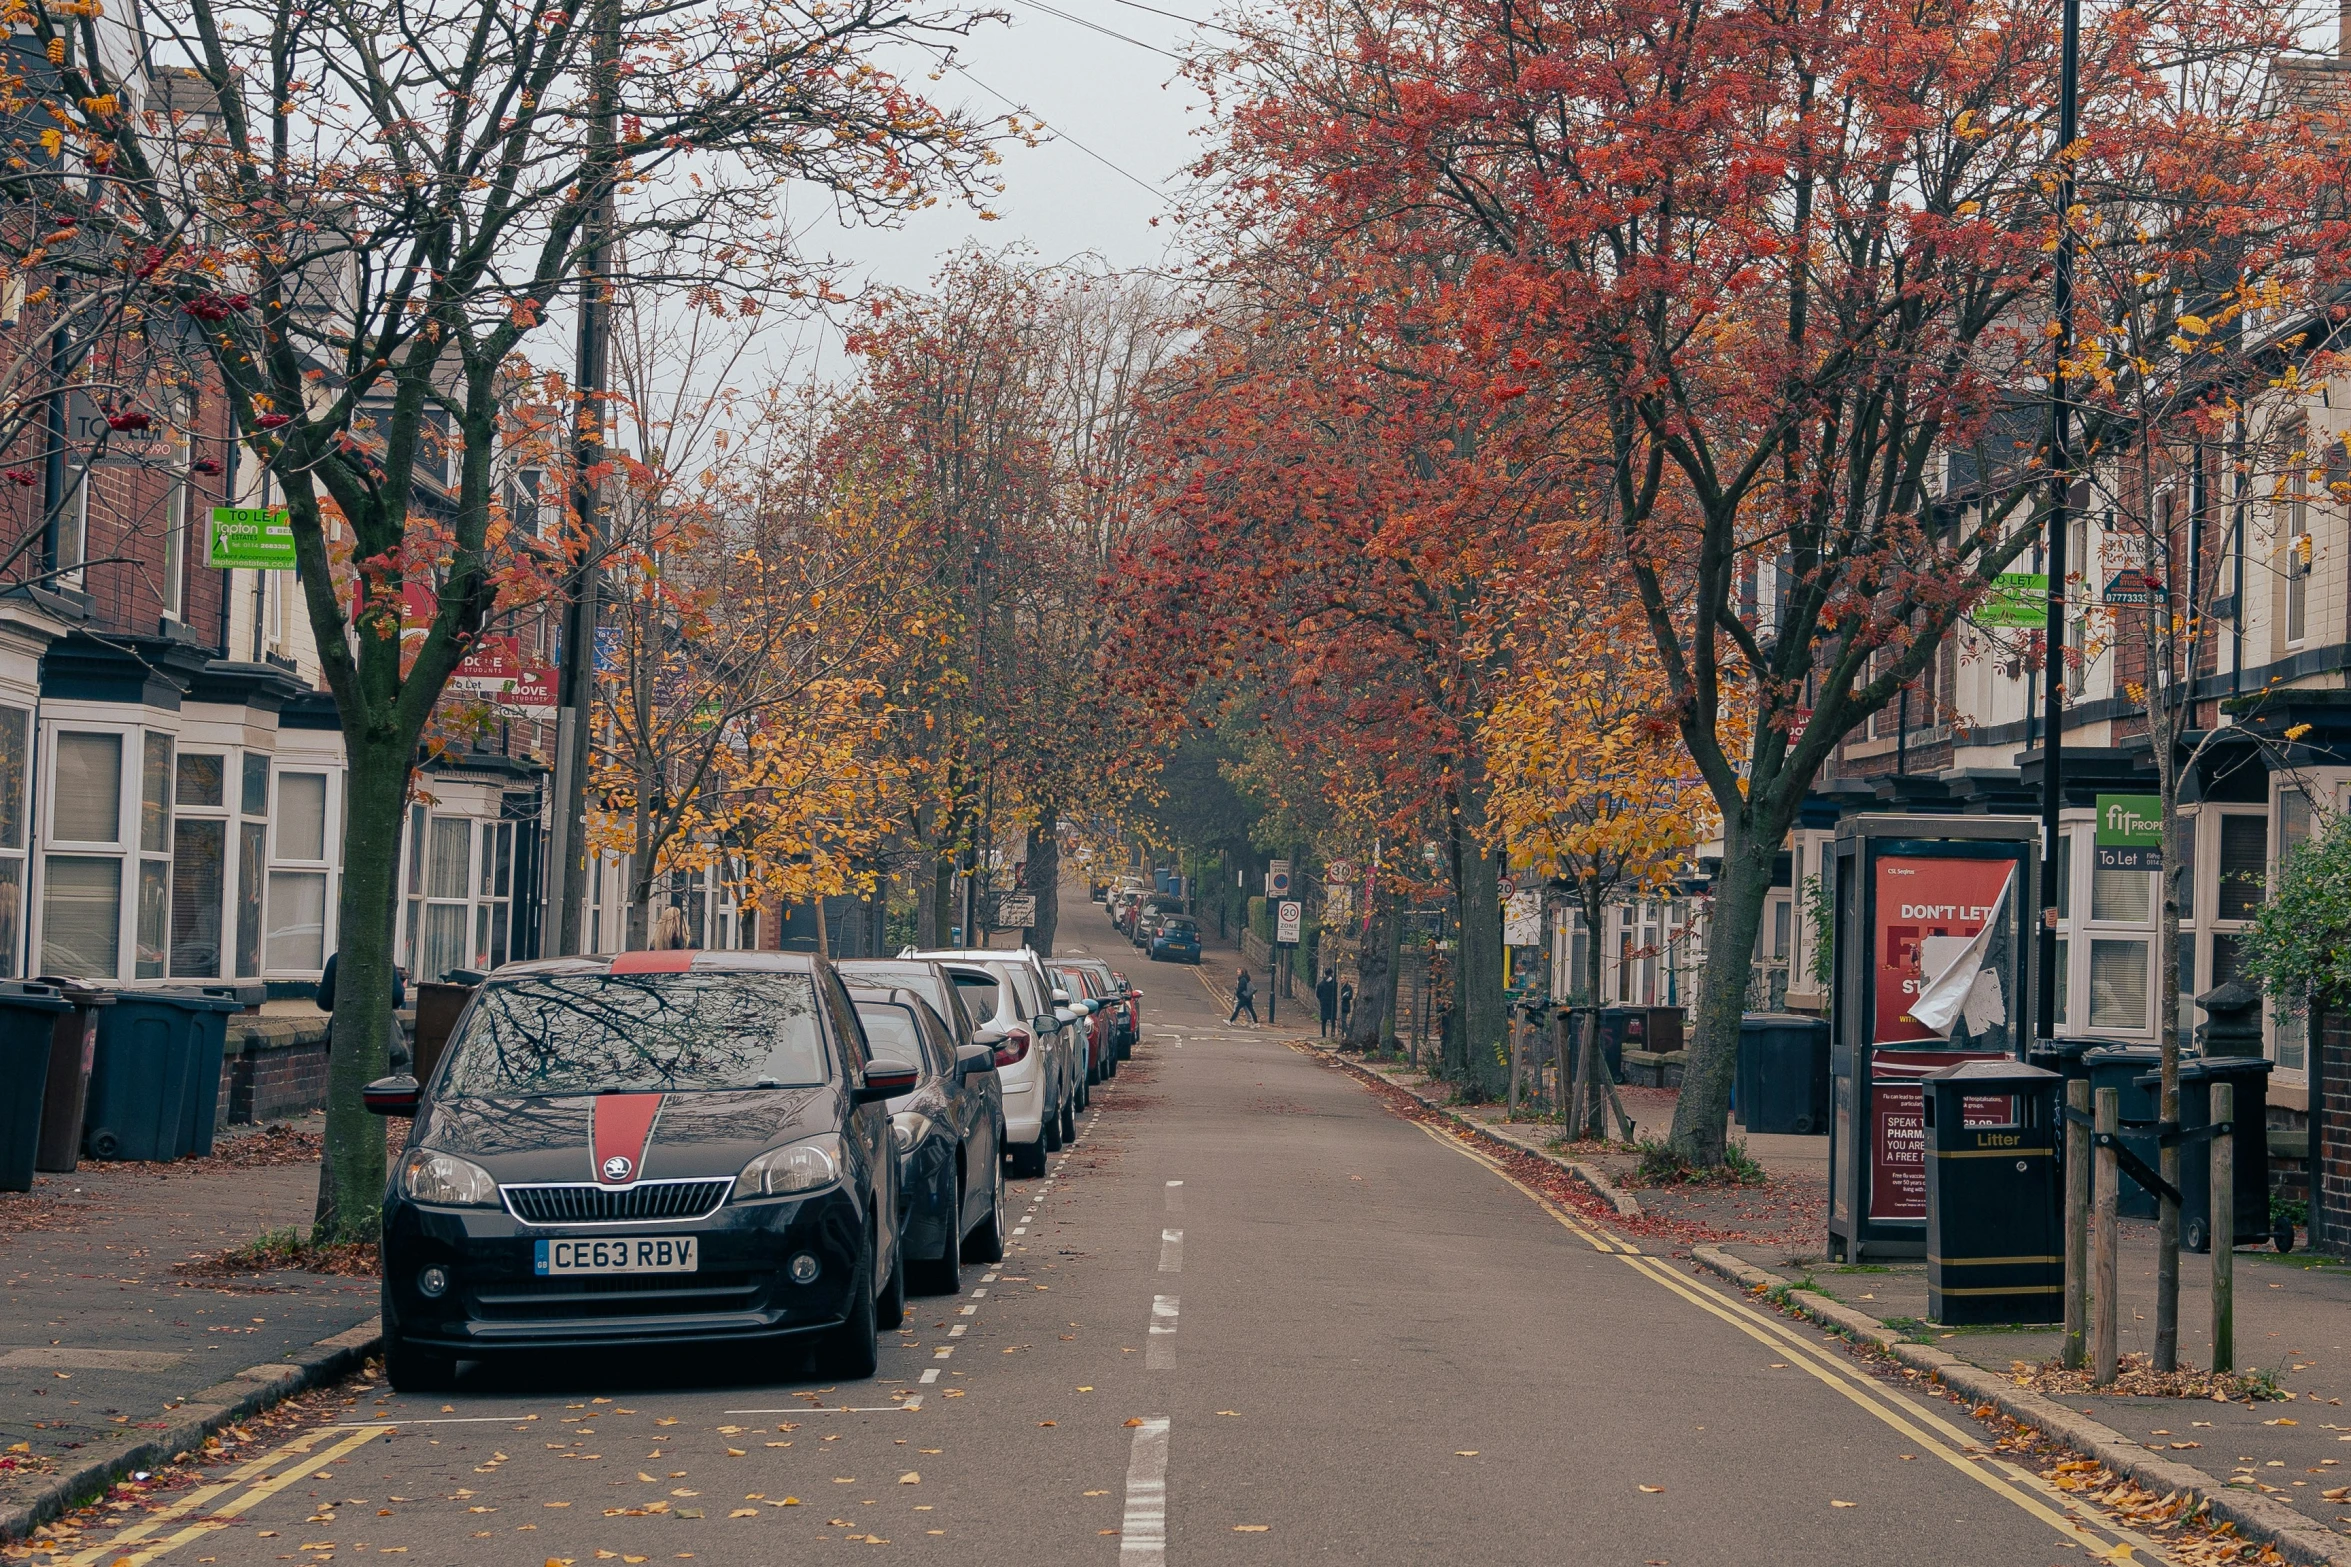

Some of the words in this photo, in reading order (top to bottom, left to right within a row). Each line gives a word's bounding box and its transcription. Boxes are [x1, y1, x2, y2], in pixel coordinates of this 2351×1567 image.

[229, 510, 248, 521] TO
[254, 511, 281, 522] LET
[214, 521, 258, 535] Tapton
[212, 559, 296, 568] taptonestates.co.uk
[2010, 575, 2033, 585] LET
[464, 656, 503, 667] DOE
[465, 680, 482, 689] Let
[511, 686, 548, 696] DOVE
[2099, 850, 2115, 865] To
[2117, 850, 2138, 866] Let
[1332, 865, 1350, 876] 30
[1497, 884, 1512, 893] 20
[1283, 909, 1297, 917] 20
[1901, 904, 1956, 920] DON'T
[1959, 906, 1992, 921] LET
[1887, 1117, 1918, 1127] SPEAK
[1887, 1128, 1925, 1139] PHARM
[1887, 1140, 1906, 1150] YOU
[1908, 1141, 1925, 1150] ARE
[1977, 1133, 2021, 1147] Litter
[1886, 1152, 1894, 1161] A
[1895, 1152, 1918, 1162] FREE
[537, 1261, 548, 1269] GB
[555, 1241, 628, 1268] CE63
[637, 1240, 691, 1267] RBV
